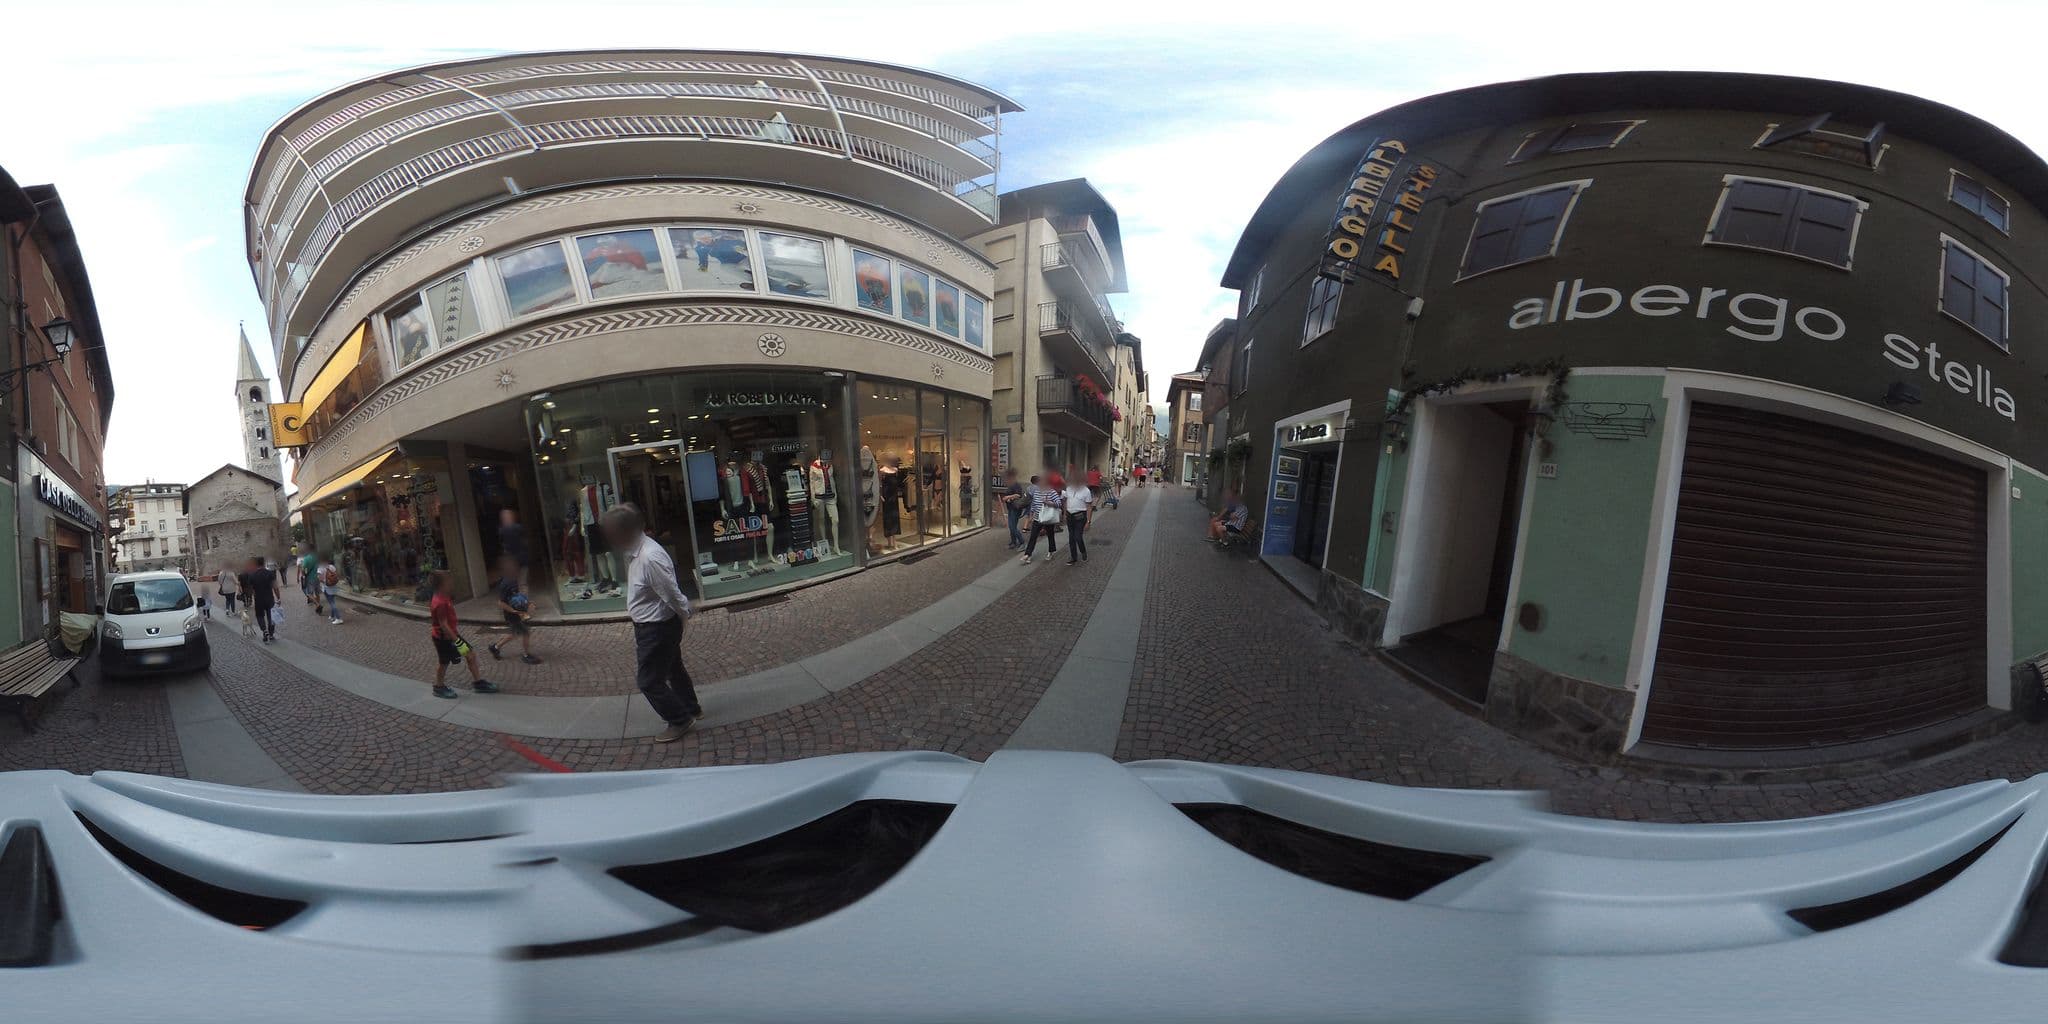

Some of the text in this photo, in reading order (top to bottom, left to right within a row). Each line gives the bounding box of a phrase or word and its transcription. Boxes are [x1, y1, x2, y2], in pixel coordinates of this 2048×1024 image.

[1328, 139, 1408, 259] ALBERGO
[1375, 165, 1439, 279] STELLA
[1508, 278, 2016, 421] albergo stella
[713, 514, 768, 536] SALDI
